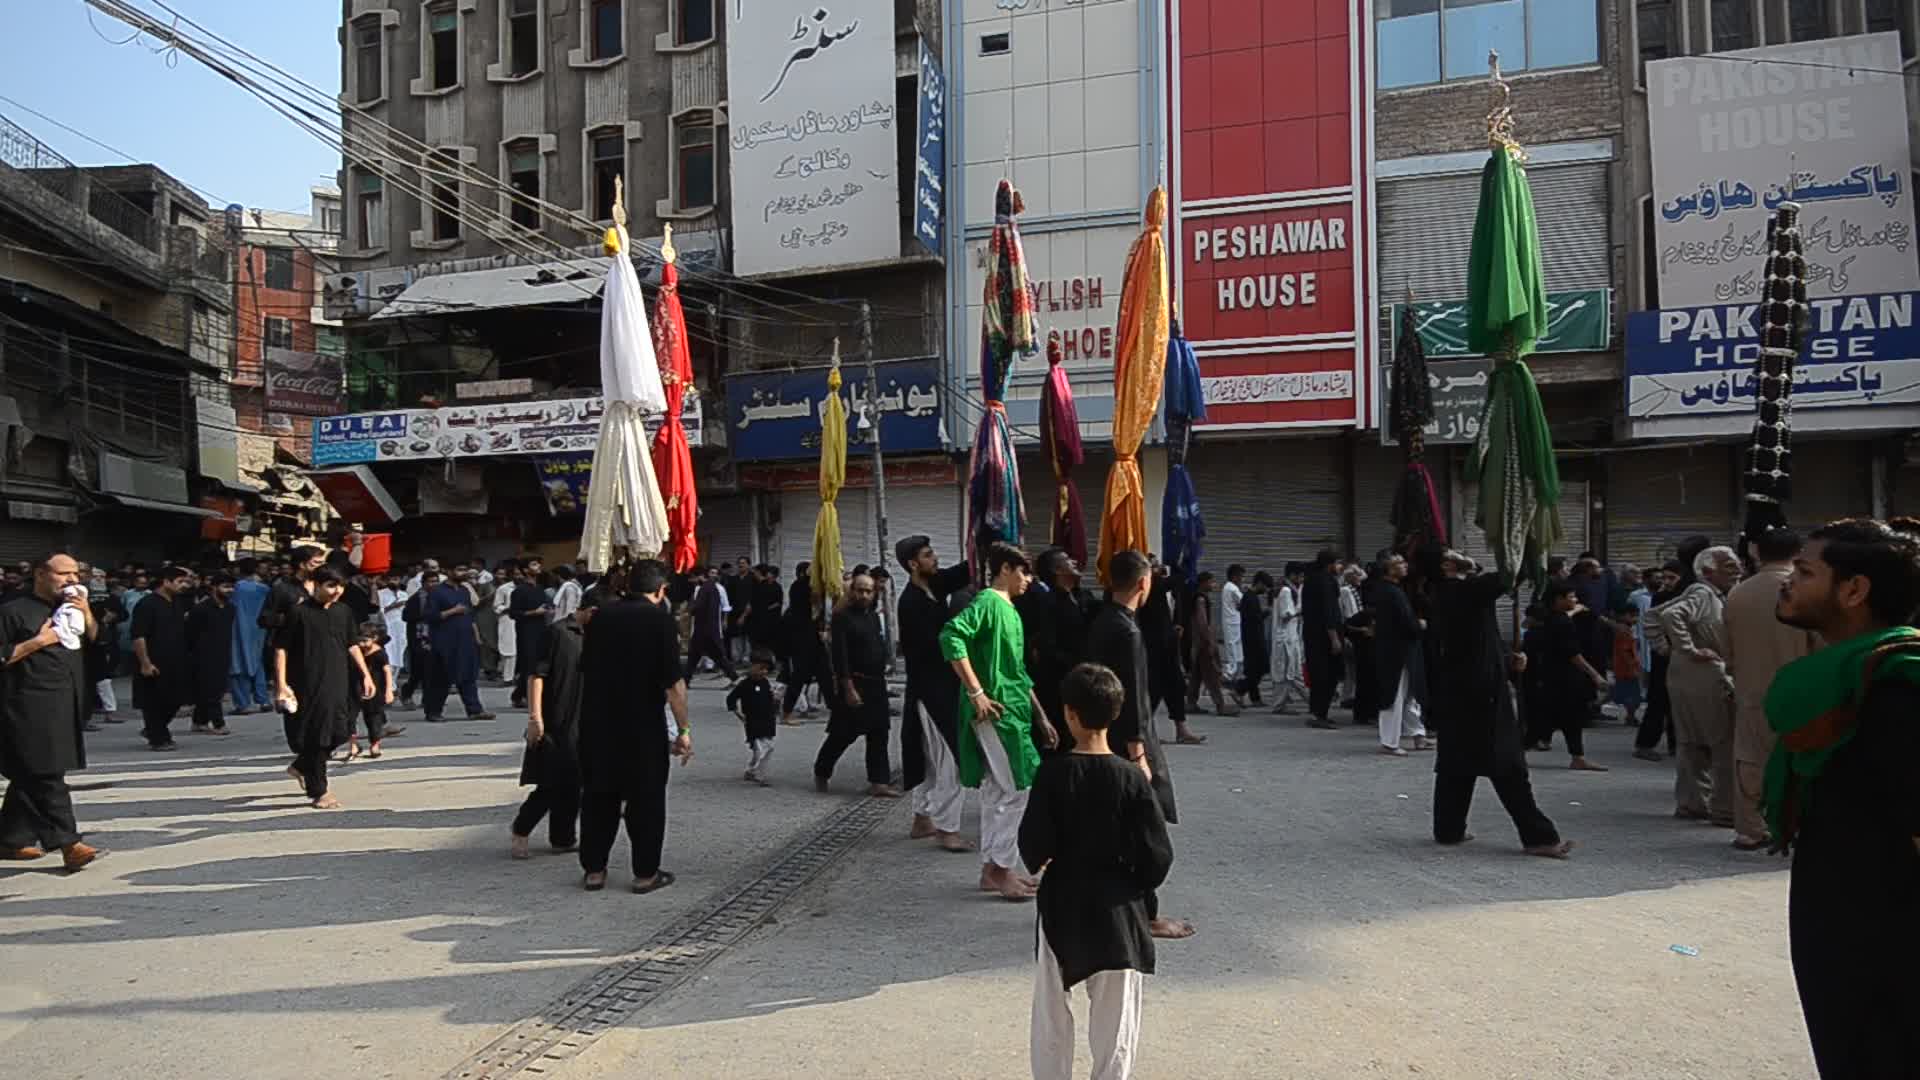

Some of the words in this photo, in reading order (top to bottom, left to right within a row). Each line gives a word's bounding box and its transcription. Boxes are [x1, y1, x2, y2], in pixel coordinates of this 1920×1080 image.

[1662, 42, 1886, 108] PAKISTAN
[1699, 97, 1857, 152] HOUSE
[1194, 218, 1347, 262] PESHAWAR
[1218, 272, 1317, 310] HOUSE
[1659, 294, 1912, 343] PAKTAN
[1695, 336, 1875, 366] HOSE
[321, 414, 406, 433] DUBAI
